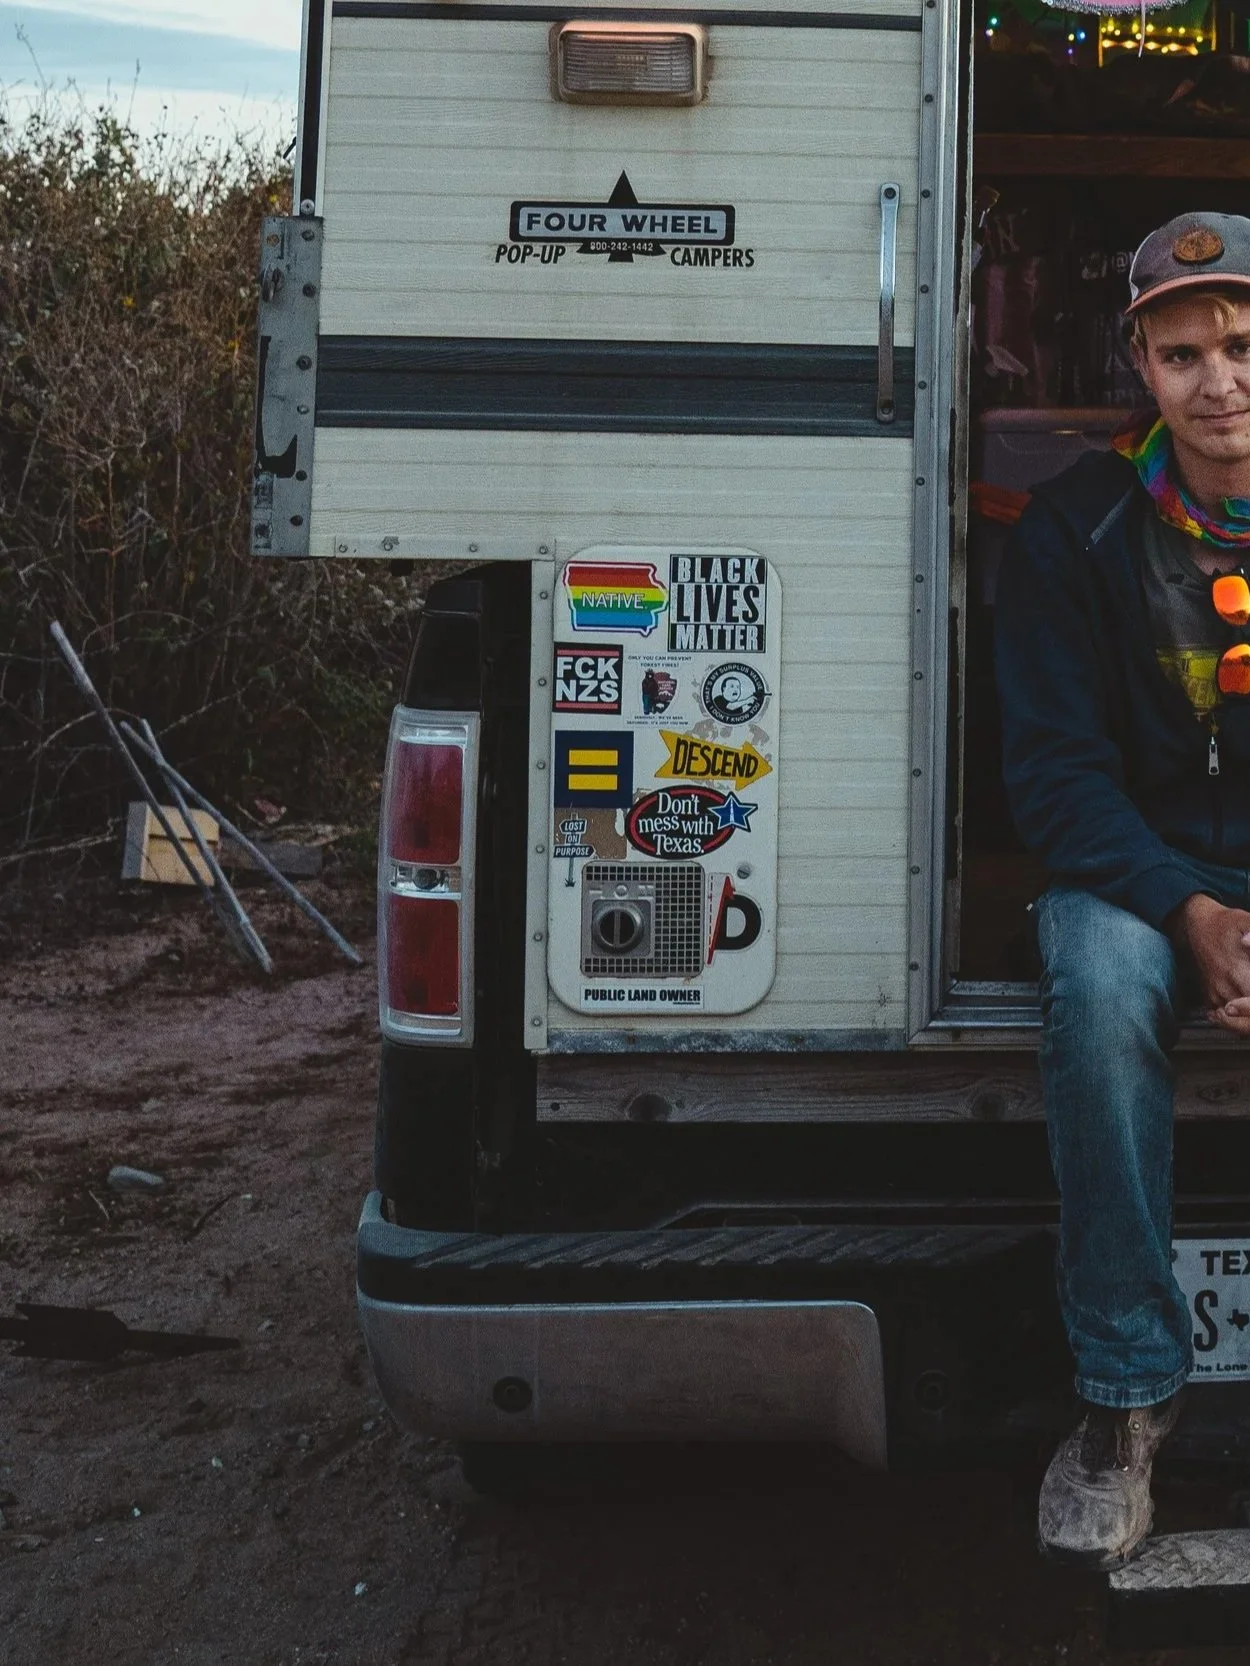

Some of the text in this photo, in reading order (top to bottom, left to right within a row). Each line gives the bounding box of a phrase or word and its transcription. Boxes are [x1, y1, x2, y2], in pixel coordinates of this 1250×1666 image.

[526, 213, 717, 234] FOUR WHEEL
[495, 244, 566, 264] POP-UP
[590, 241, 654, 252] 800-242-1442
[670, 247, 755, 267] CAMPERS
[677, 557, 759, 583] BLACK
[582, 592, 648, 610] NATIVE.
[676, 584, 760, 624] LIVES
[676, 624, 758, 650] MATTER
[556, 656, 619, 680] FCK
[556, 680, 619, 702] NZS
[672, 738, 759, 779] DESCEND
[657, 793, 700, 815] Don't
[564, 821, 584, 831] LOST
[638, 814, 714, 835] mess with
[567, 835, 578, 843] ON
[652, 834, 705, 856] Texas.
[555, 847, 590, 856] PURPOSE
[584, 989, 700, 1001] PUBLIC LAND OWNER
[1193, 1363, 1212, 1372] he
[1216, 1363, 1248, 1372] Lone
